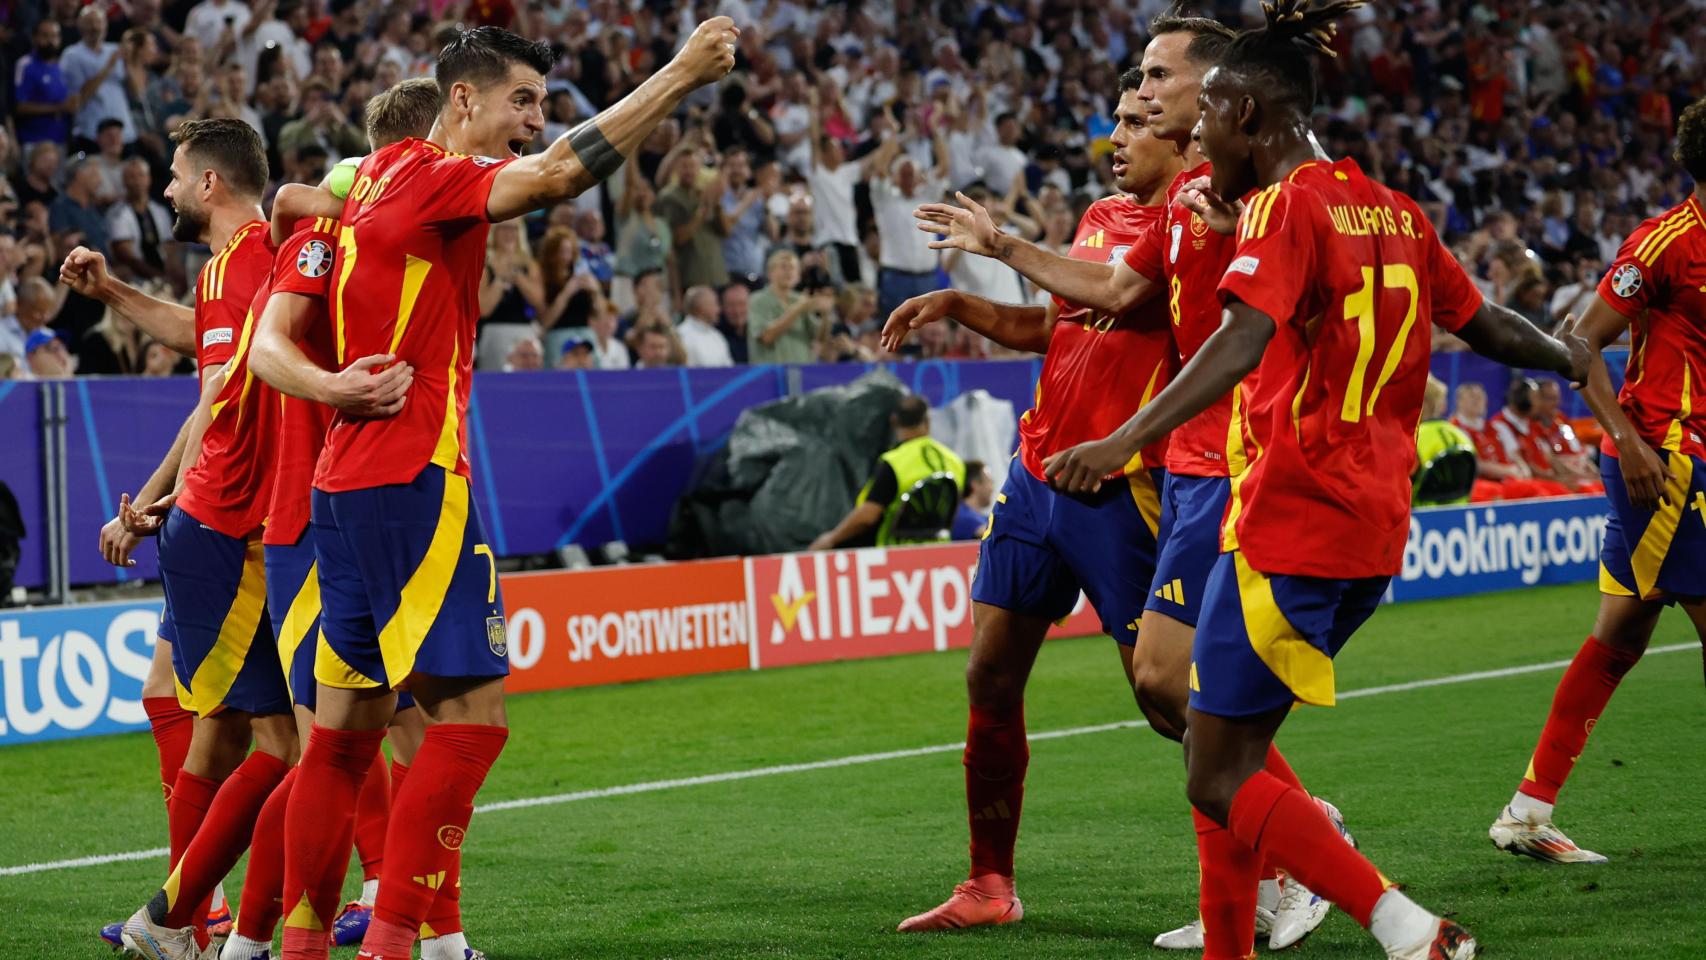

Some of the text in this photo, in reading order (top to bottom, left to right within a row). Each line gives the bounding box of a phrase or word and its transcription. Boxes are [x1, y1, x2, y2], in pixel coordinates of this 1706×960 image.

[1341, 264, 1419, 423] 17
[474, 544, 496, 603] 7
[771, 549, 1087, 651] AliExp
[0, 609, 160, 736] toS
[566, 600, 749, 662] SPORTWETTEN
